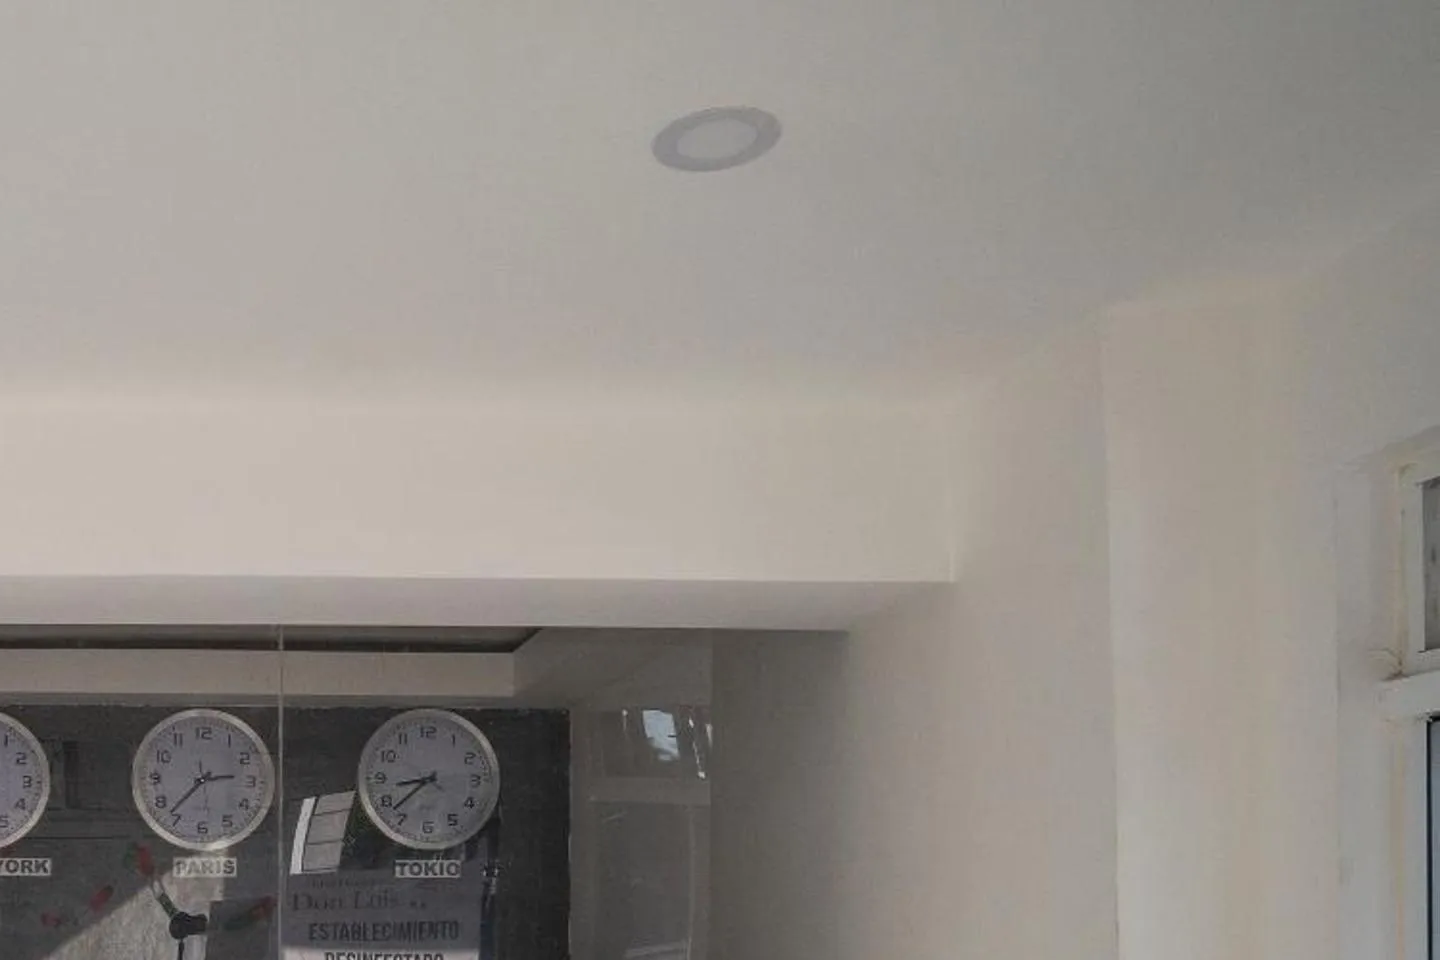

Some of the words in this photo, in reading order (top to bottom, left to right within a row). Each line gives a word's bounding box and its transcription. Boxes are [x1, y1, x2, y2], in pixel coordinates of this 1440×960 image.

[196, 727, 212, 740] 12
[420, 726, 437, 738] 12
[174, 733, 183, 747] 11
[399, 734, 407, 745] 11
[16, 752, 26, 765] 2
[157, 750, 171, 763] 10
[240, 752, 250, 765] 2
[382, 749, 396, 763] 10
[465, 752, 476, 765] 2
[23, 775, 32, 788] 3
[150, 772, 161, 785] 9
[246, 775, 256, 788] 3
[375, 772, 386, 784] 9
[471, 774, 480, 787] 3
[15, 798, 25, 810] 4
[155, 796, 166, 808] 8
[239, 798, 249, 810] 4
[381, 795, 392, 807] 8
[464, 797, 474, 808] 4
[171, 814, 181, 826] 7
[222, 814, 233, 827] 5
[397, 813, 407, 826] 7
[447, 814, 458, 826] 5
[198, 821, 208, 834] 6
[423, 821, 434, 834] 6
[175, 860, 236, 876] PARIS
[397, 861, 460, 877] TOKIO
[308, 921, 460, 942] ESTABLECIMIENTO
